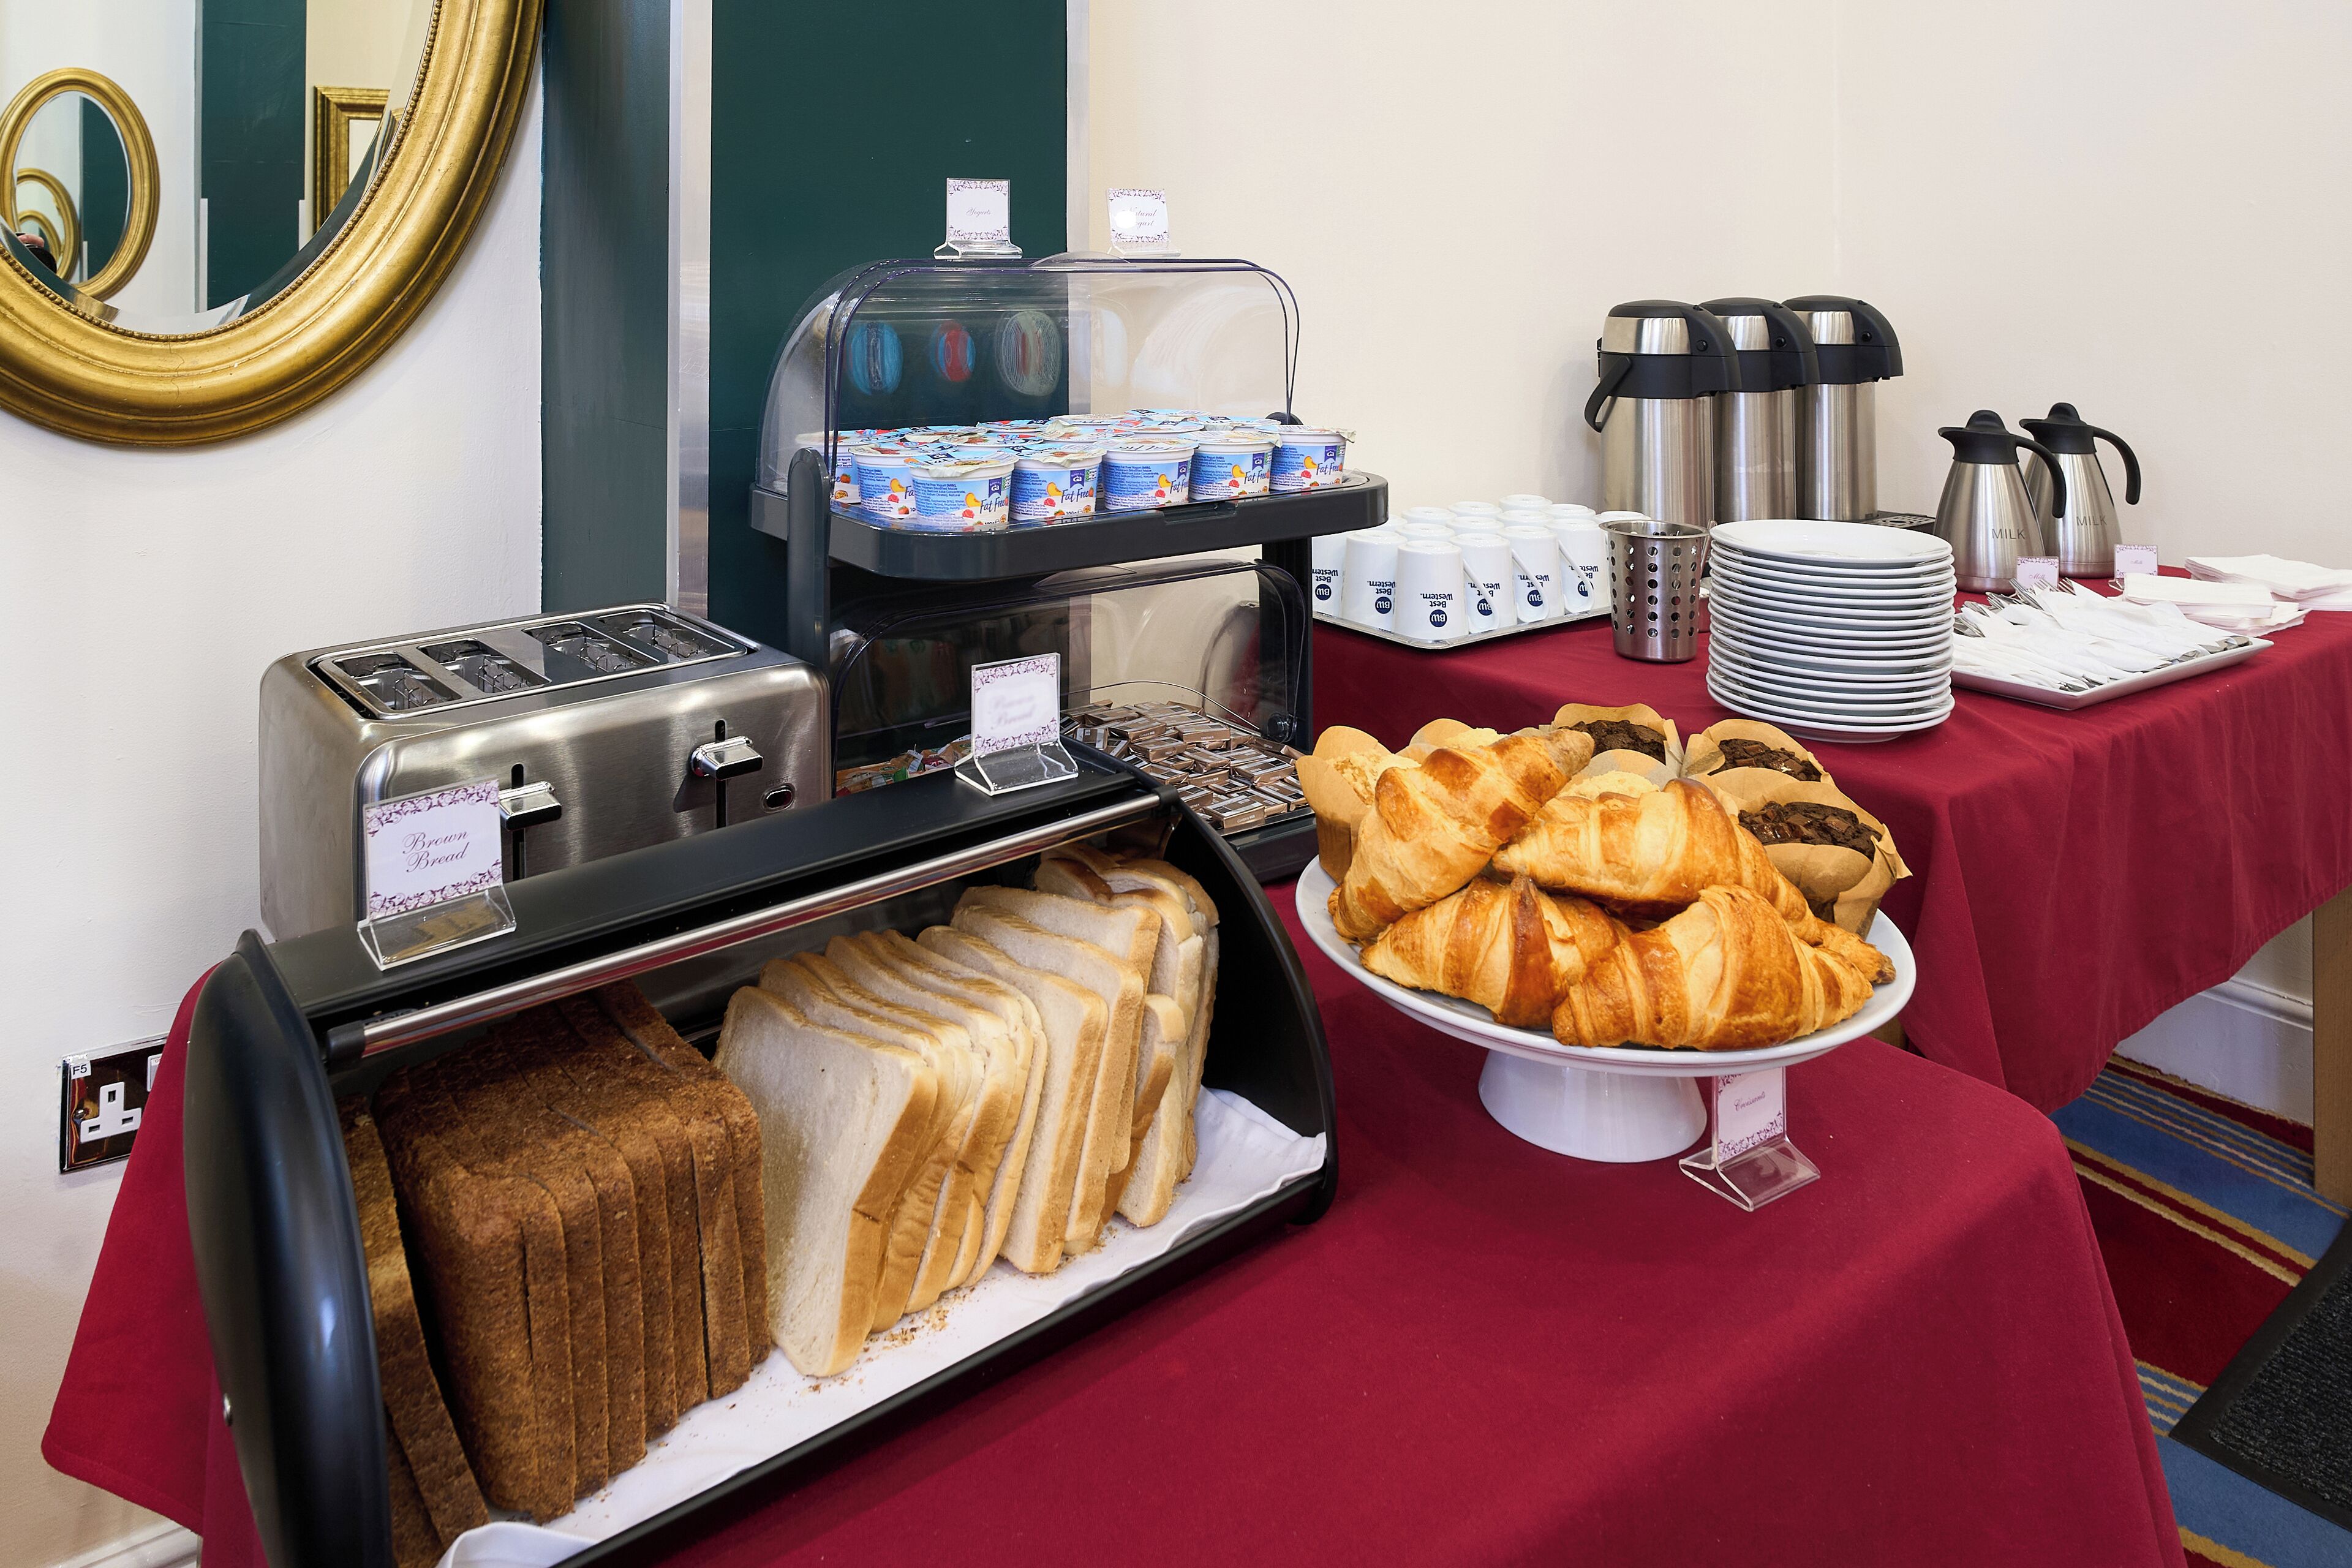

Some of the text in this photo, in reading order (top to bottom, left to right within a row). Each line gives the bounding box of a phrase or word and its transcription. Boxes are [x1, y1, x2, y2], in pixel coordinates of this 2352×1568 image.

[1316, 462, 1328, 475] Fat
[1244, 471, 1256, 484] Fat
[1170, 480, 1181, 494] Fat
[1061, 489, 1076, 503] Fat
[1076, 488, 1089, 502] Free
[980, 499, 993, 514] Fat
[2076, 515, 2108, 526] MILK
[1992, 529, 2026, 540] MILK
[1431, 614, 1446, 622] BW
[402, 831, 467, 854] Brown
[406, 842, 470, 873] Bread
[72, 1063, 88, 1076] F5
